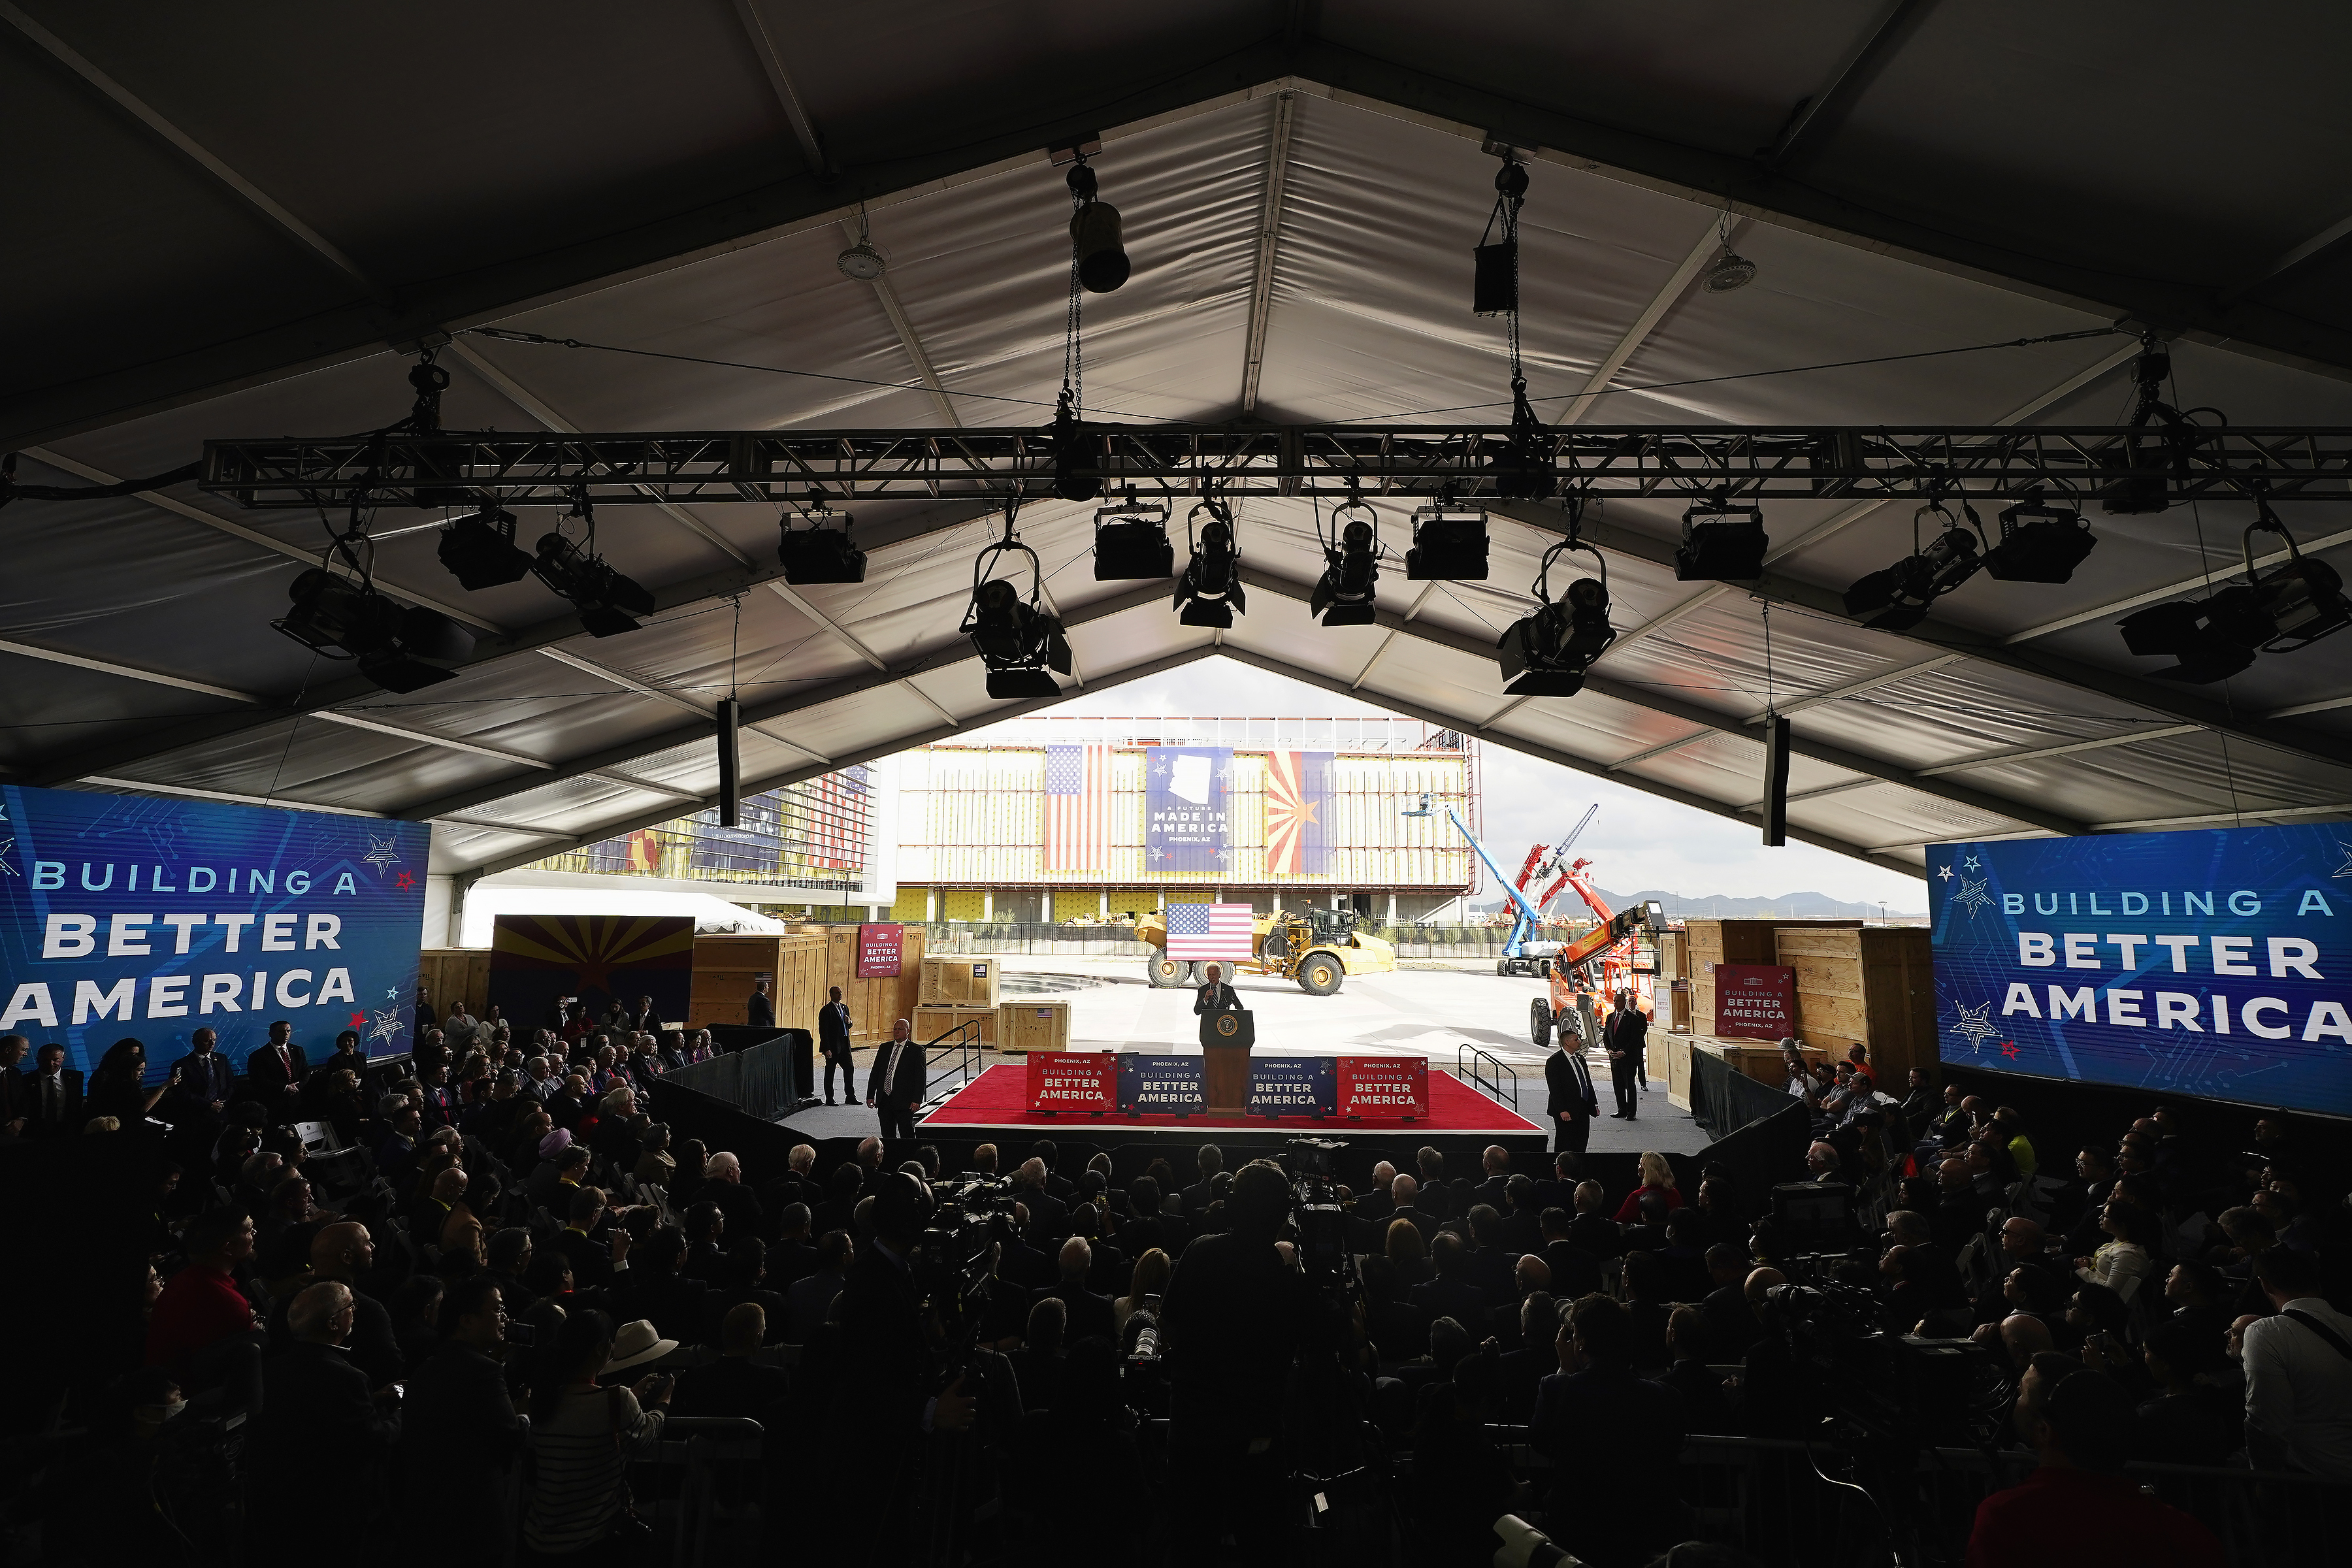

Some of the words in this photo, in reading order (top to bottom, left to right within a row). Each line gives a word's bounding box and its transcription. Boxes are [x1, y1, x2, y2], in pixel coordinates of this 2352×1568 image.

[1154, 812, 1201, 821] MADE
[1209, 812, 1226, 821] IN
[1151, 823, 1228, 833] AMERICA
[31, 860, 311, 895] BUILDING
[333, 872, 357, 896] A
[2002, 889, 2262, 917] BUILDING
[2296, 890, 2334, 917] A
[42, 913, 342, 958] BETTER
[2017, 932, 2325, 979] BETTER
[0, 967, 355, 1030] AMERICA
[1727, 998, 1781, 1008] BETTER
[1723, 1008, 1786, 1019] AMERICA
[2001, 982, 2352, 1045] AMERICA
[1045, 1078, 1100, 1088] BETTER
[1143, 1081, 1198, 1090] BETTER
[1256, 1083, 1311, 1092] BETTER
[1355, 1083, 1411, 1093] BETTER
[1039, 1090, 1103, 1100] AMERICA
[1137, 1093, 1203, 1103] AMERICA
[1250, 1095, 1316, 1105] AMERICA
[1350, 1095, 1416, 1105] AMERICA
